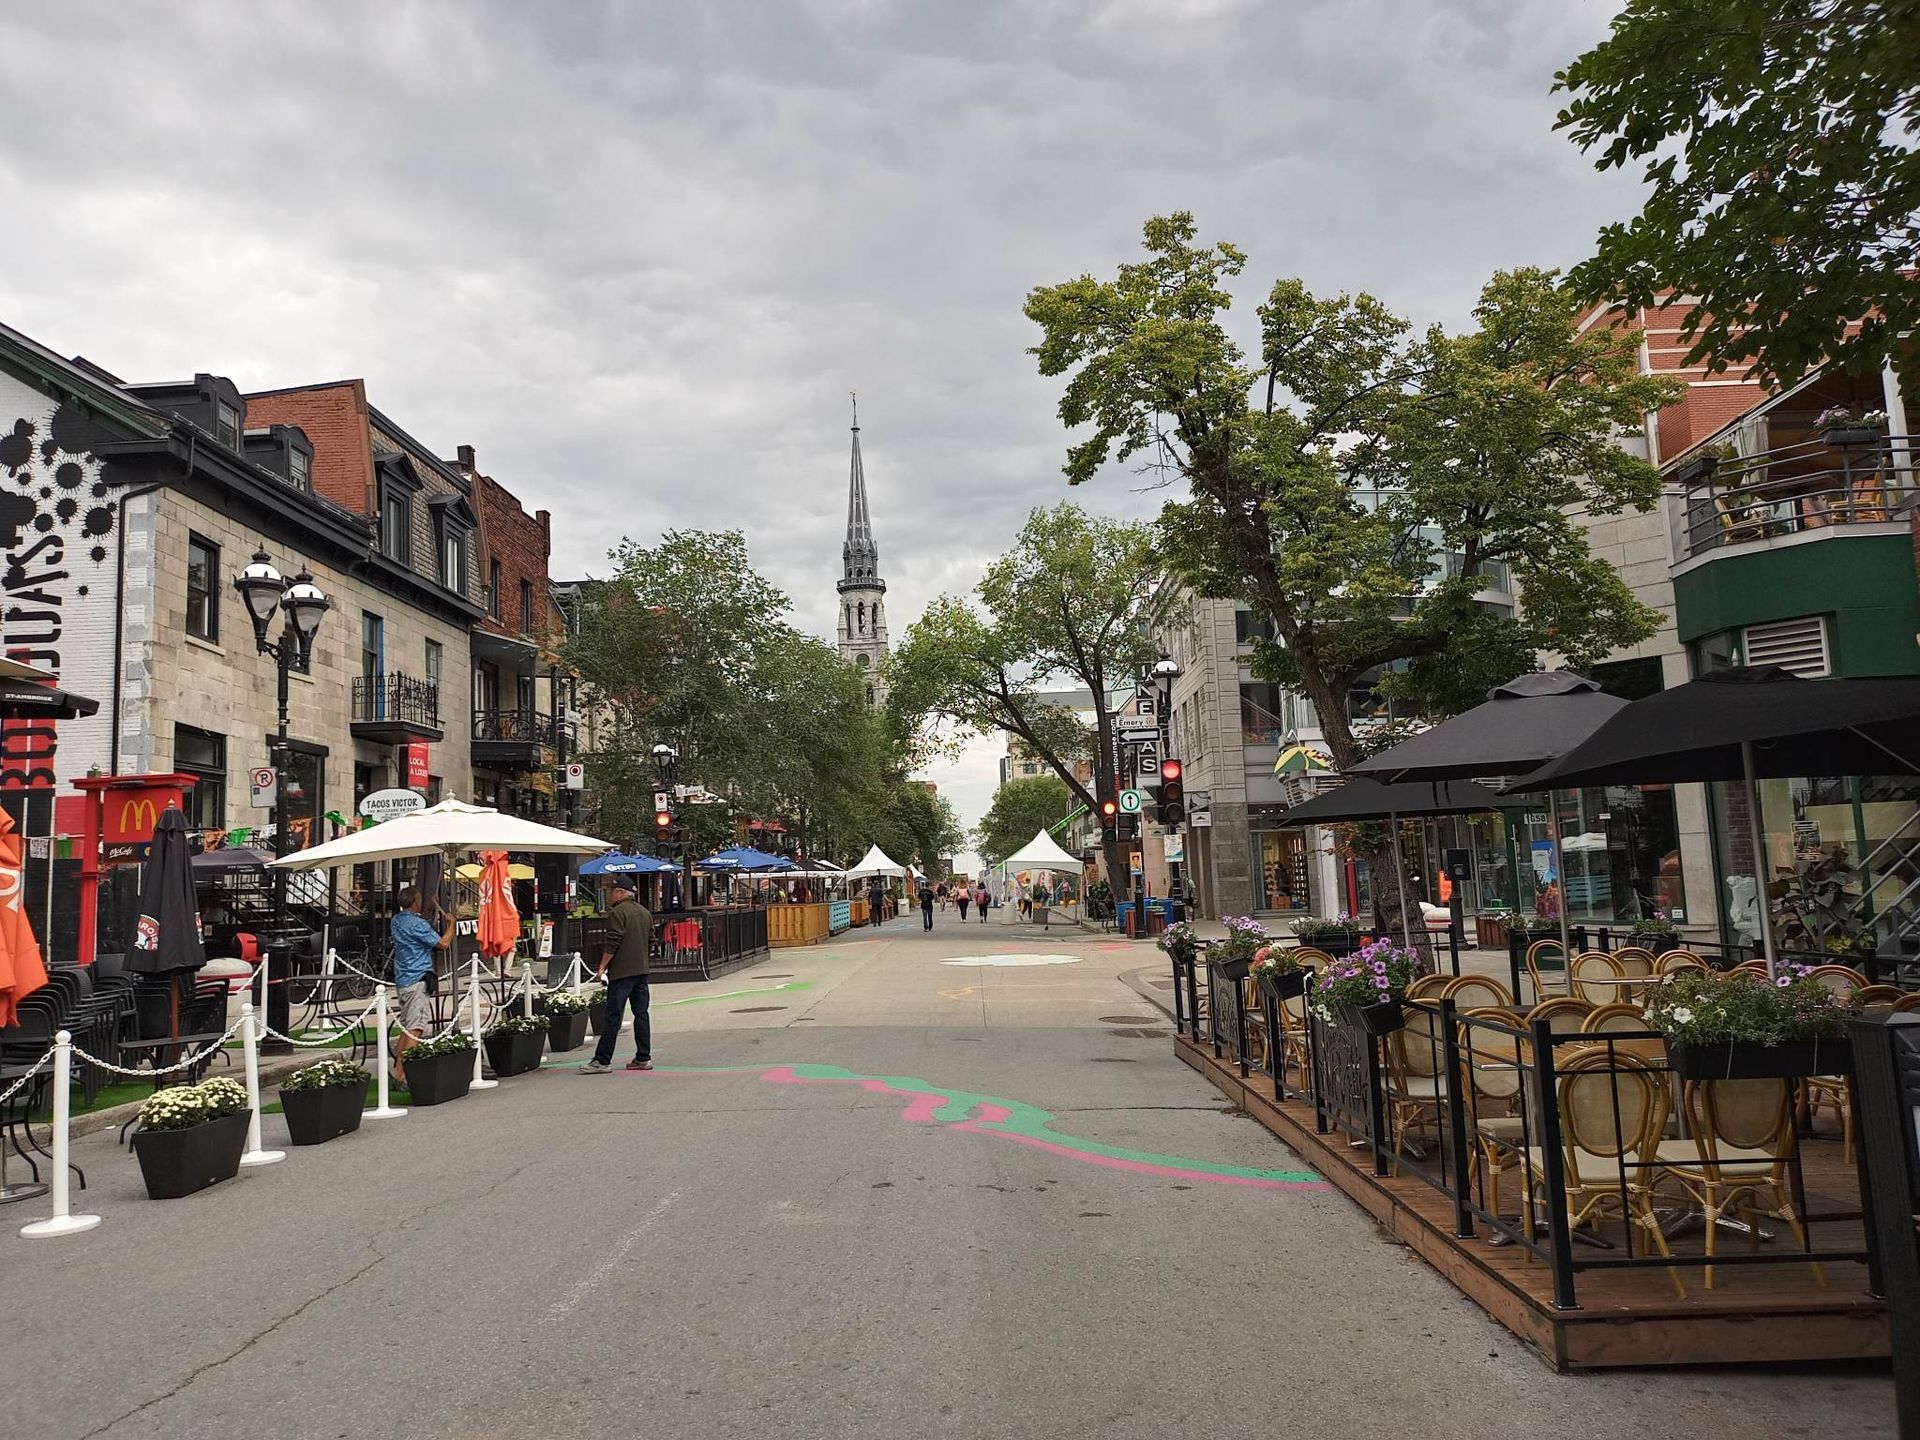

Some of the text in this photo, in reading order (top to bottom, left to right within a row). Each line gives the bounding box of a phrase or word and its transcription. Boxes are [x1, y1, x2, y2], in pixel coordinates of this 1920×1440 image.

[1119, 719, 1143, 727] Emery
[410, 757, 424, 766] LOCAL
[367, 798, 418, 809] TACOS VICTOR
